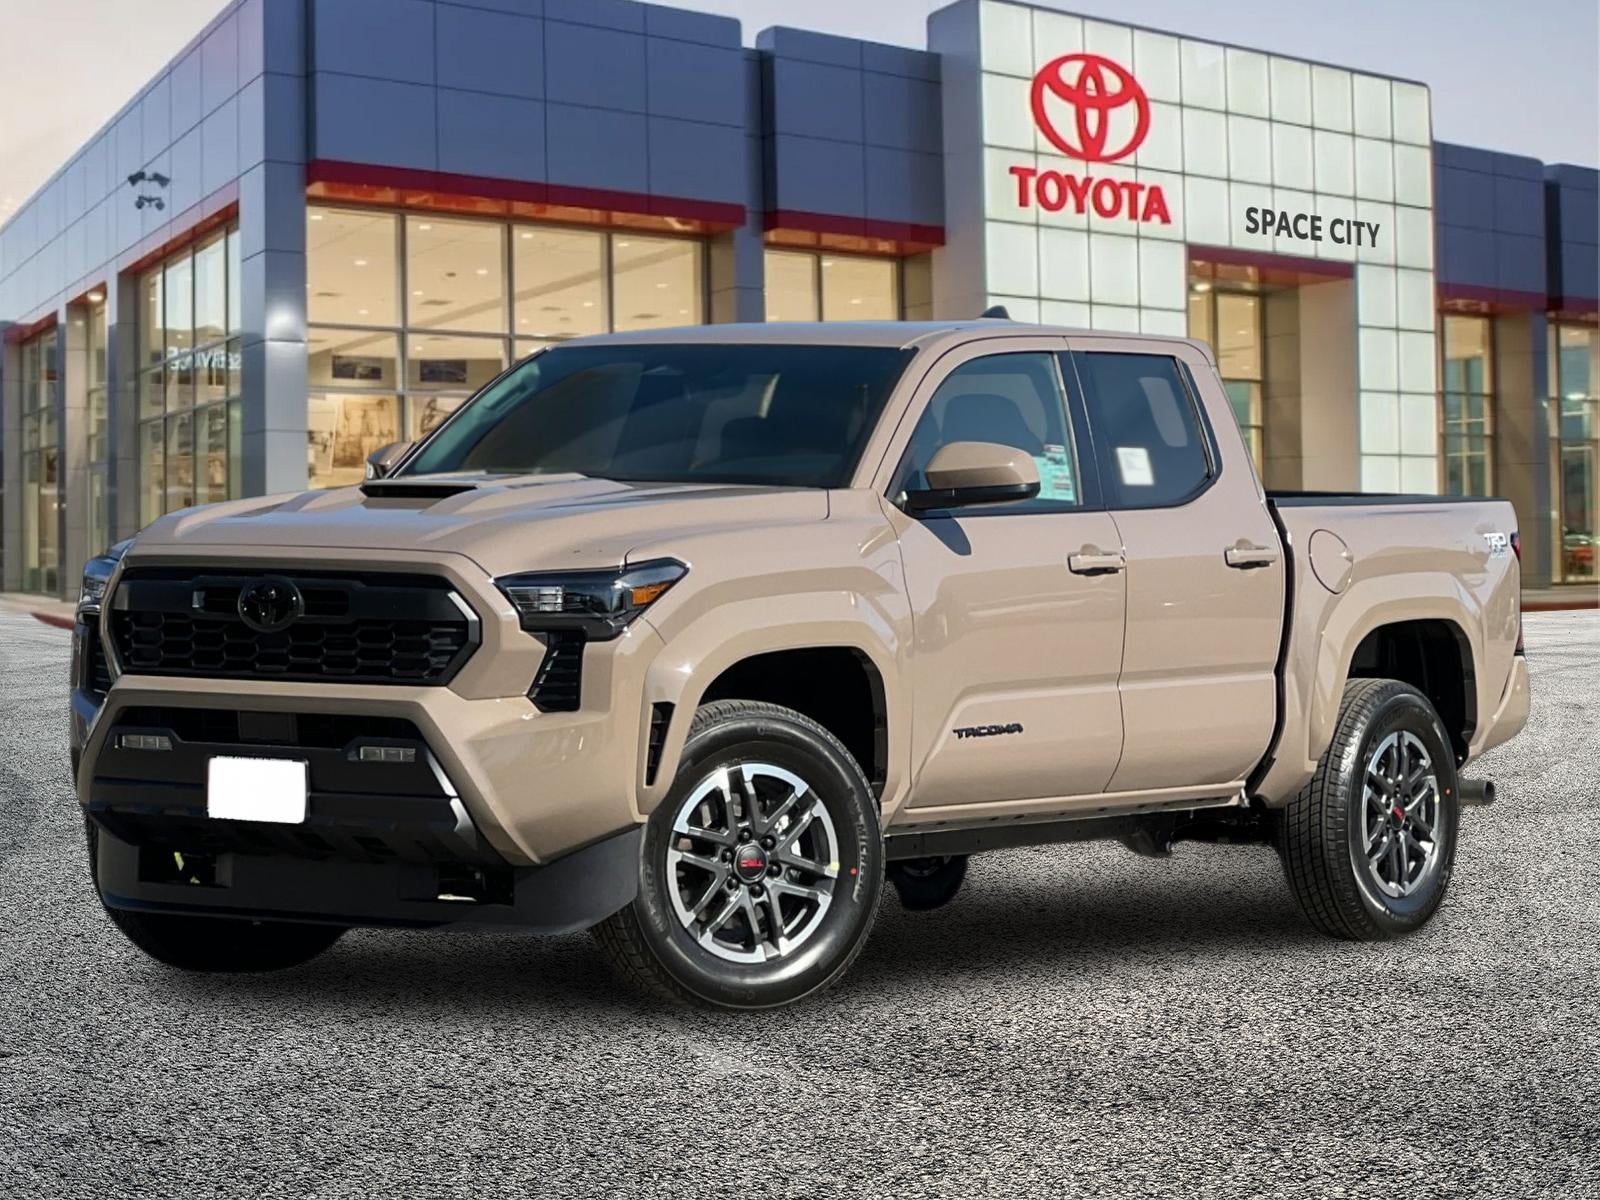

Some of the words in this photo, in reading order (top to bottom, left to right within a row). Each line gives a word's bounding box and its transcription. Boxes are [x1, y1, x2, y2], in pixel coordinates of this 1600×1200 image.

[1009, 166, 1171, 224] TOYOTA
[1245, 206, 1322, 242] SPACE
[1329, 217, 1381, 248] CITY
[953, 723, 1024, 739] TACOMA
